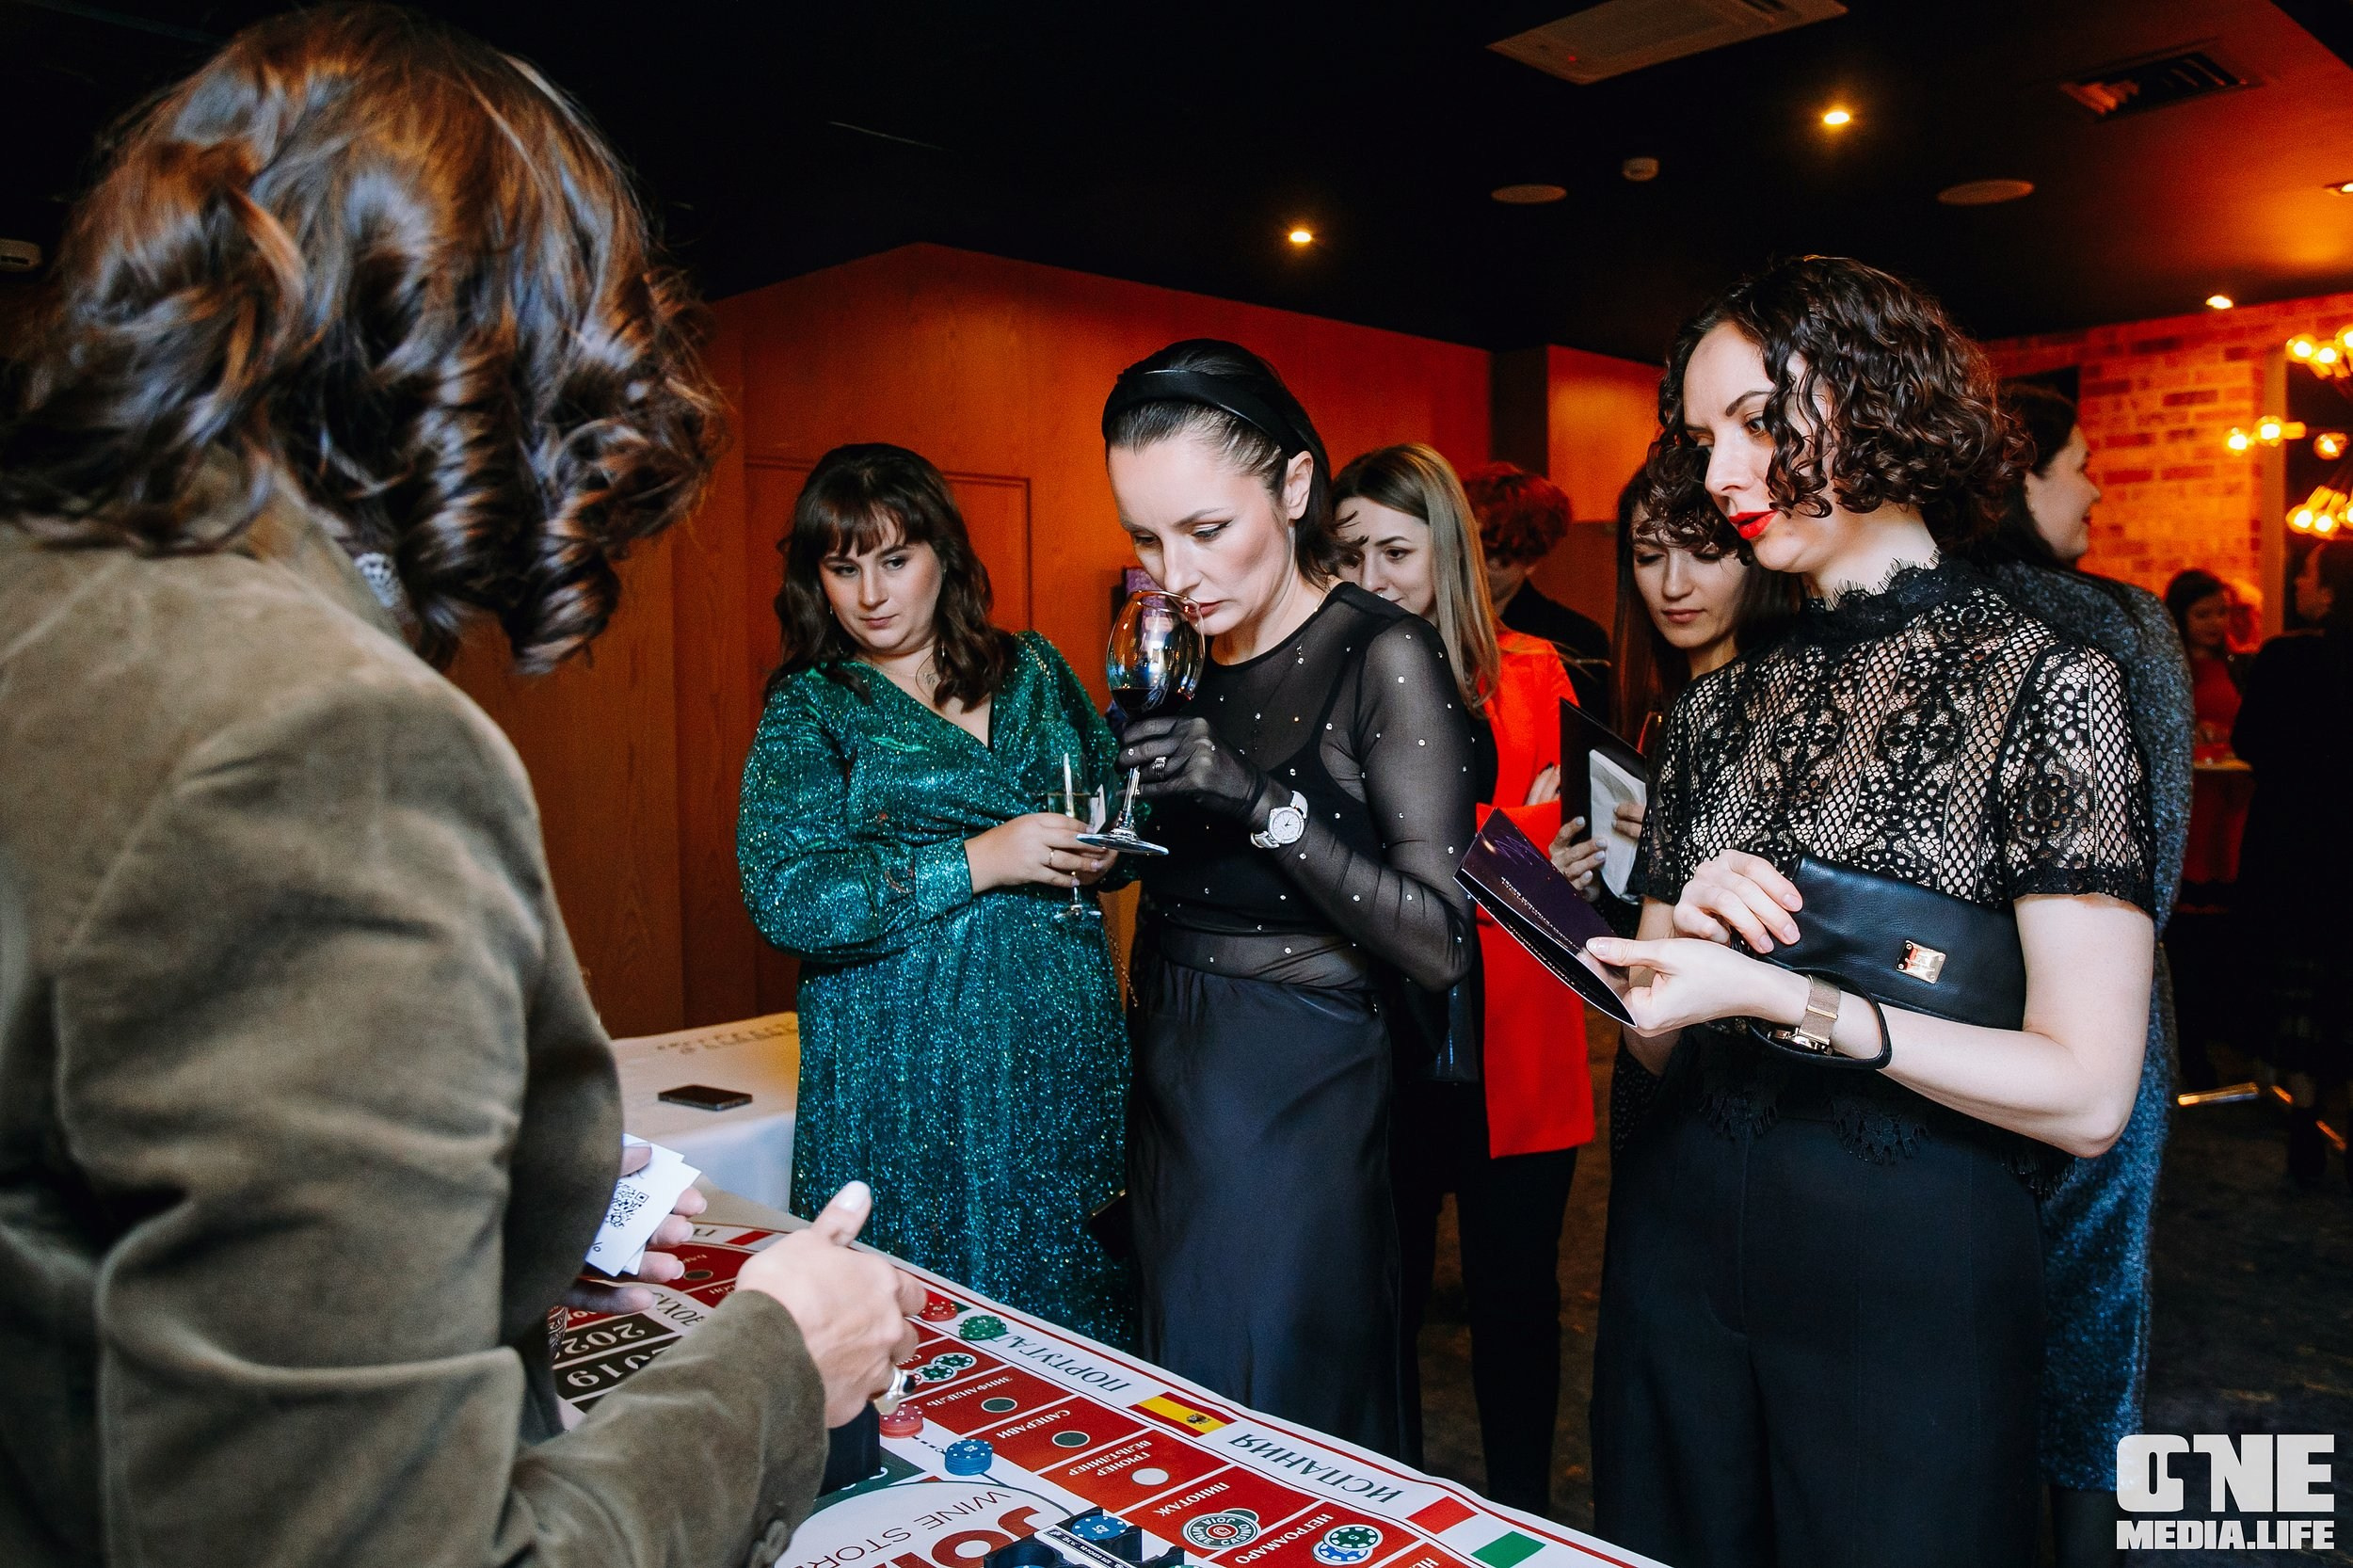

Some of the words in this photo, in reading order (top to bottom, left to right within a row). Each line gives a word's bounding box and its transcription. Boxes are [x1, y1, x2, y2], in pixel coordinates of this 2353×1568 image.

[553, 1322, 646, 1360] 202
[960, 1325, 1132, 1393] ПОРТУГАЛ
[926, 1375, 1014, 1408] ЗИНФАНДЕЛЬ
[996, 1409, 1072, 1440] САПЕРАВИ
[1068, 1439, 1153, 1477] ВЕЛЬТЛИНЕР
[1096, 1451, 1151, 1477] ГРЮНЕР
[1227, 1433, 1404, 1503] ИСПАНИЯ
[913, 1491, 1012, 1530] WINE
[1153, 1481, 1231, 1517] ПИНОТАЖ
[1192, 1526, 1215, 1545] WINE
[1221, 1523, 1253, 1545] CASINO
[1201, 1517, 1236, 1527] JOIA
[1235, 1512, 1335, 1564] НЕГРОАМАРО
[793, 1527, 912, 1568] STOR
